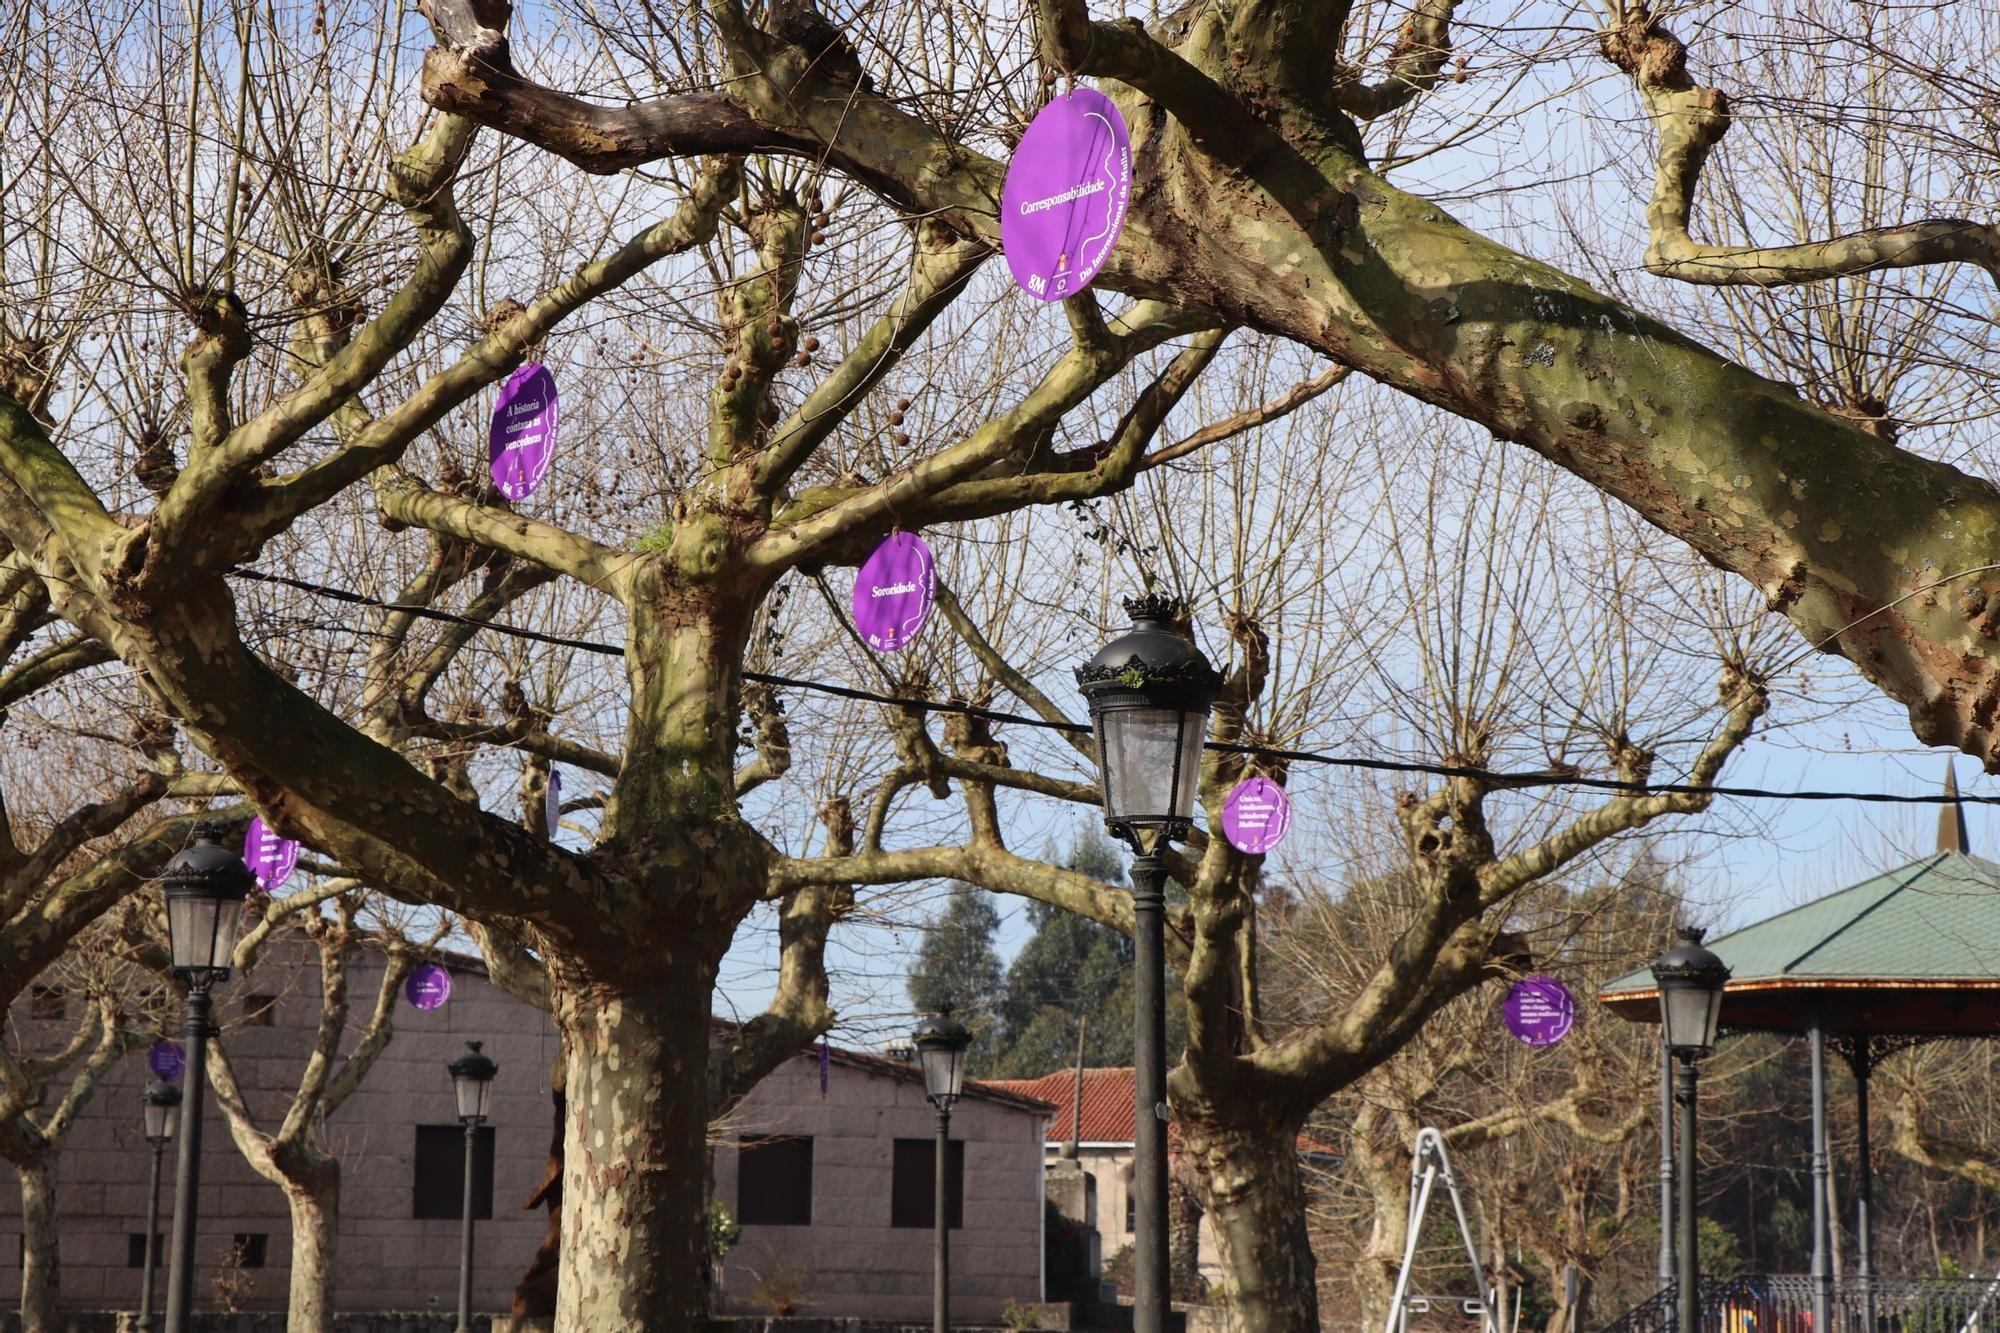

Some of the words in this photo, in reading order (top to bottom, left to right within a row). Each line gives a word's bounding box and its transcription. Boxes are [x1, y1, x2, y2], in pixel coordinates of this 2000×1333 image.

[1120, 146, 1128, 182] Muller
[1020, 177, 1105, 216] Corresponsabilidade
[1119, 184, 1128, 199] da
[1091, 201, 1125, 268] Internacional
[1028, 273, 1046, 295] 8M
[507, 405, 513, 418] A
[513, 399, 540, 416] historia
[533, 417, 541, 427] as
[505, 433, 542, 451] vencedoras
[872, 581, 916, 598] Sororidade
[869, 633, 882, 648] 8M
